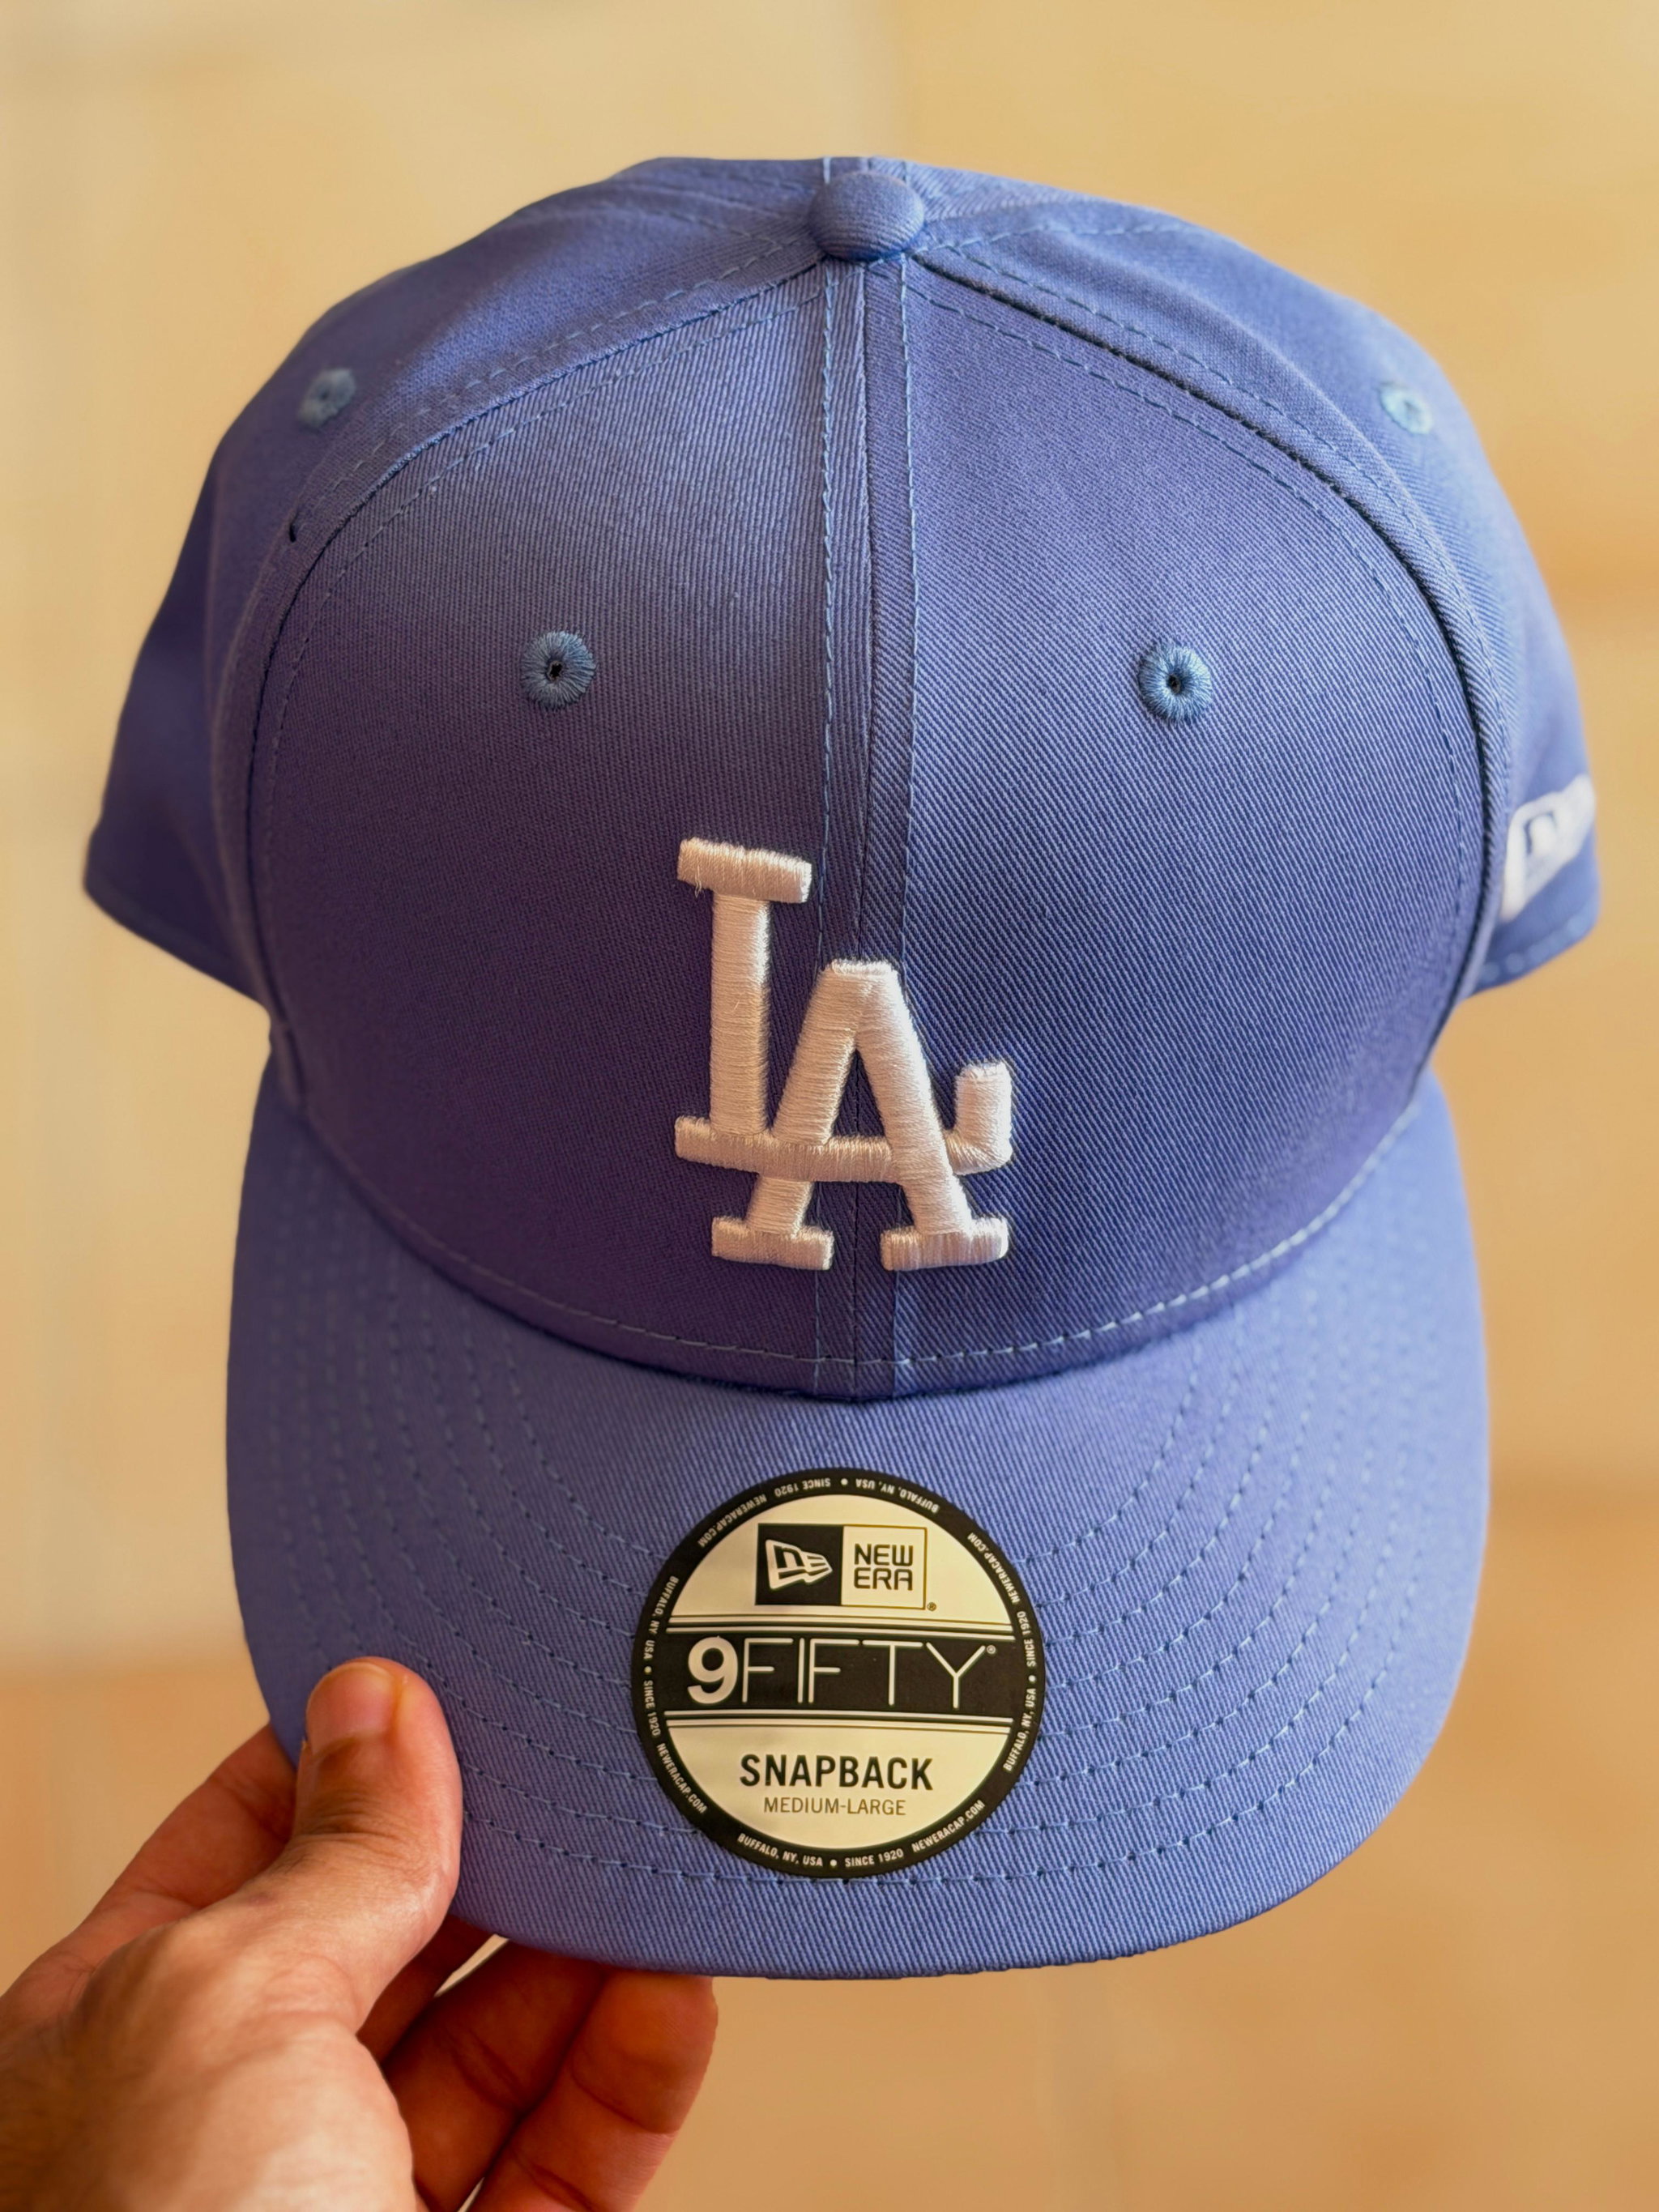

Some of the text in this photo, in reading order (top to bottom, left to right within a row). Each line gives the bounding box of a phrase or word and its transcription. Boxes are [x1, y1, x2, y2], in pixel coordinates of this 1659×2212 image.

[675, 837, 1013, 1271] LA
[774, 1483, 799, 1498] 1920
[802, 1477, 831, 1490] SINCE
[855, 1478, 876, 1490] USA
[698, 1494, 767, 1547] NEWERACAP.COM
[854, 1543, 914, 1566] NEW
[853, 1567, 913, 1592] ERA
[966, 1532, 1021, 1605] NEWERACAP.COM
[1016, 1610, 1032, 1636] 1920
[643, 1639, 655, 1660] USA
[1023, 1638, 1038, 1668] SINCE
[643, 1680, 655, 1709] SINCE
[1024, 1688, 1037, 1709] USA
[647, 1711, 661, 1737] 1920
[657, 1743, 707, 1813] NEWERACAP.COM
[739, 1754, 933, 1791] SNAPBACK
[763, 1796, 906, 1816] MEDIUM-LARGE
[802, 1855, 823, 1867] USA
[844, 1854, 875, 1868] SINCE
[877, 1848, 904, 1863] 1920
[911, 1799, 986, 1853] NEWERACAP.COM
